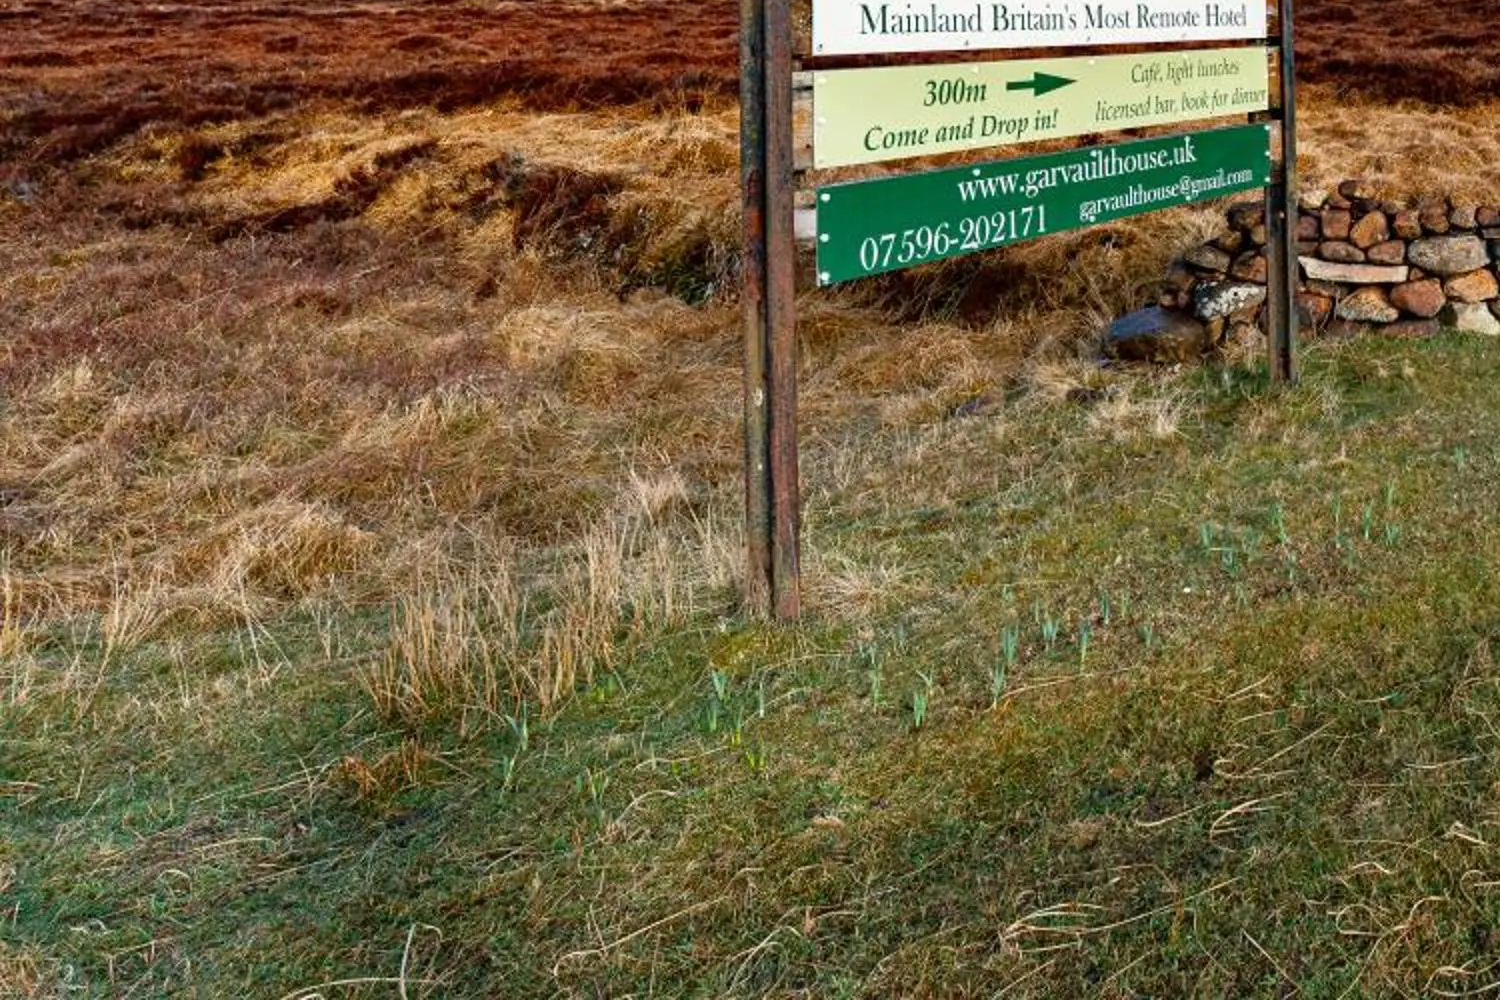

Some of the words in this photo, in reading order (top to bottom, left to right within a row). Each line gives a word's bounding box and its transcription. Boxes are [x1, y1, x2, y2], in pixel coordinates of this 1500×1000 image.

[860, 3, 982, 35] Mainland
[992, 3, 1077, 31] Britain's
[1085, 3, 1129, 29] Most
[1137, 3, 1200, 28] Remote
[1205, 3, 1247, 27] Hotel
[1166, 61, 1193, 86] light
[1197, 57, 1240, 78] lunches
[923, 77, 987, 107] 300m
[1095, 95, 1150, 122] licensed
[1181, 90, 1209, 112] book
[1210, 90, 1228, 114] for
[1231, 87, 1266, 105] dinner
[864, 125, 929, 151] Come
[935, 116, 975, 143] and
[981, 114, 1028, 140] Drop
[1034, 108, 1059, 131] in!
[957, 137, 1198, 202] www.garvaulthouse.uk
[1079, 168, 1253, 221] garvaulthouse@gmail.com
[860, 204, 1046, 271] 07596-202171
